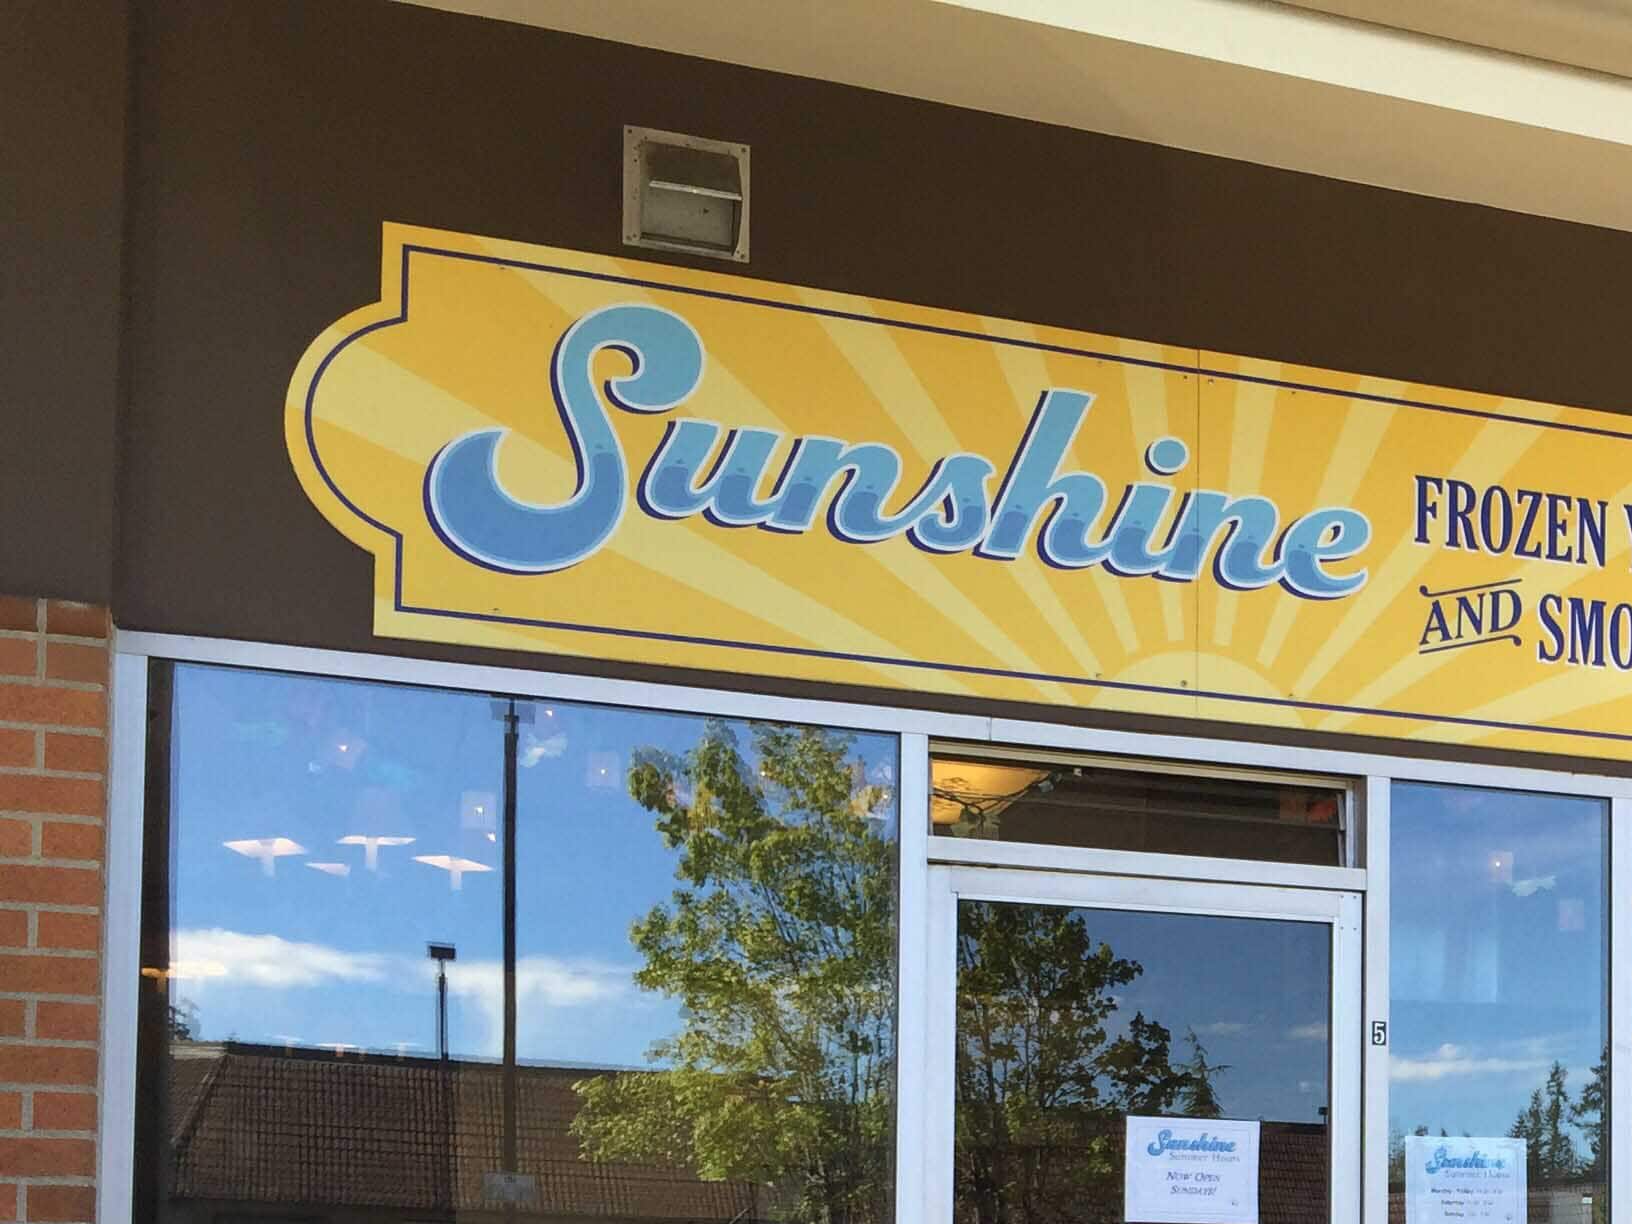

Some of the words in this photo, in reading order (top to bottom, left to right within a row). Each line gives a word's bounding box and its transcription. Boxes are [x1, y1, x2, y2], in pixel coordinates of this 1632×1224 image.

[422, 302, 1371, 599] Sunshine
[1414, 475, 1608, 568] FROZEN
[1418, 588, 1523, 646] AND
[1374, 1022, 1385, 1044] 5
[1147, 1129, 1237, 1156] Sunshine
